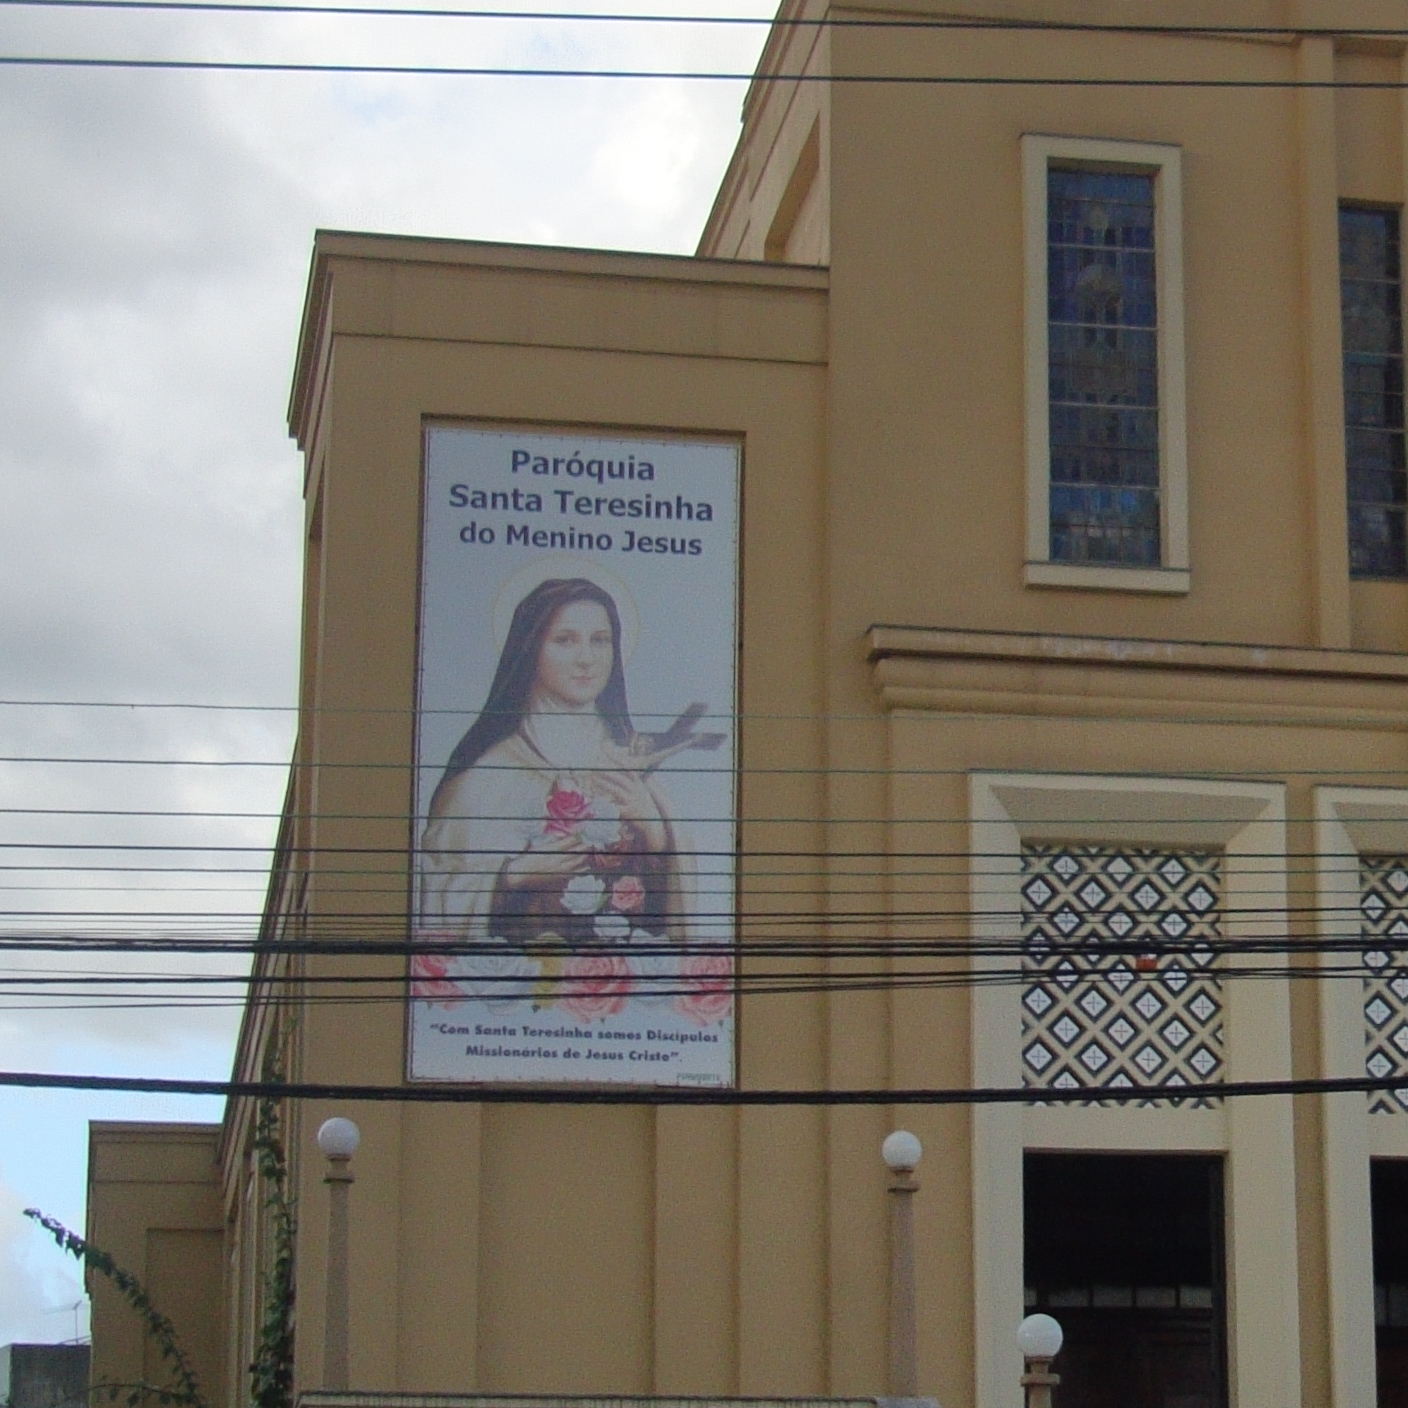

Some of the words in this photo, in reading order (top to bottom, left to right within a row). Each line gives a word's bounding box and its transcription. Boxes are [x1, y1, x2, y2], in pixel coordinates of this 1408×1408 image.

[511, 449, 655, 484] Paróquia
[449, 483, 542, 513] Santa
[554, 489, 713, 522] Teresinha
[459, 521, 496, 544] do
[506, 524, 613, 551] Menino
[621, 530, 703, 556] Jesus
[475, 1023, 517, 1037] Santa
[521, 1025, 593, 1040] Teresinha
[597, 1029, 642, 1041] somos
[562, 1047, 581, 1060] de
[585, 1048, 624, 1061] Jesus
